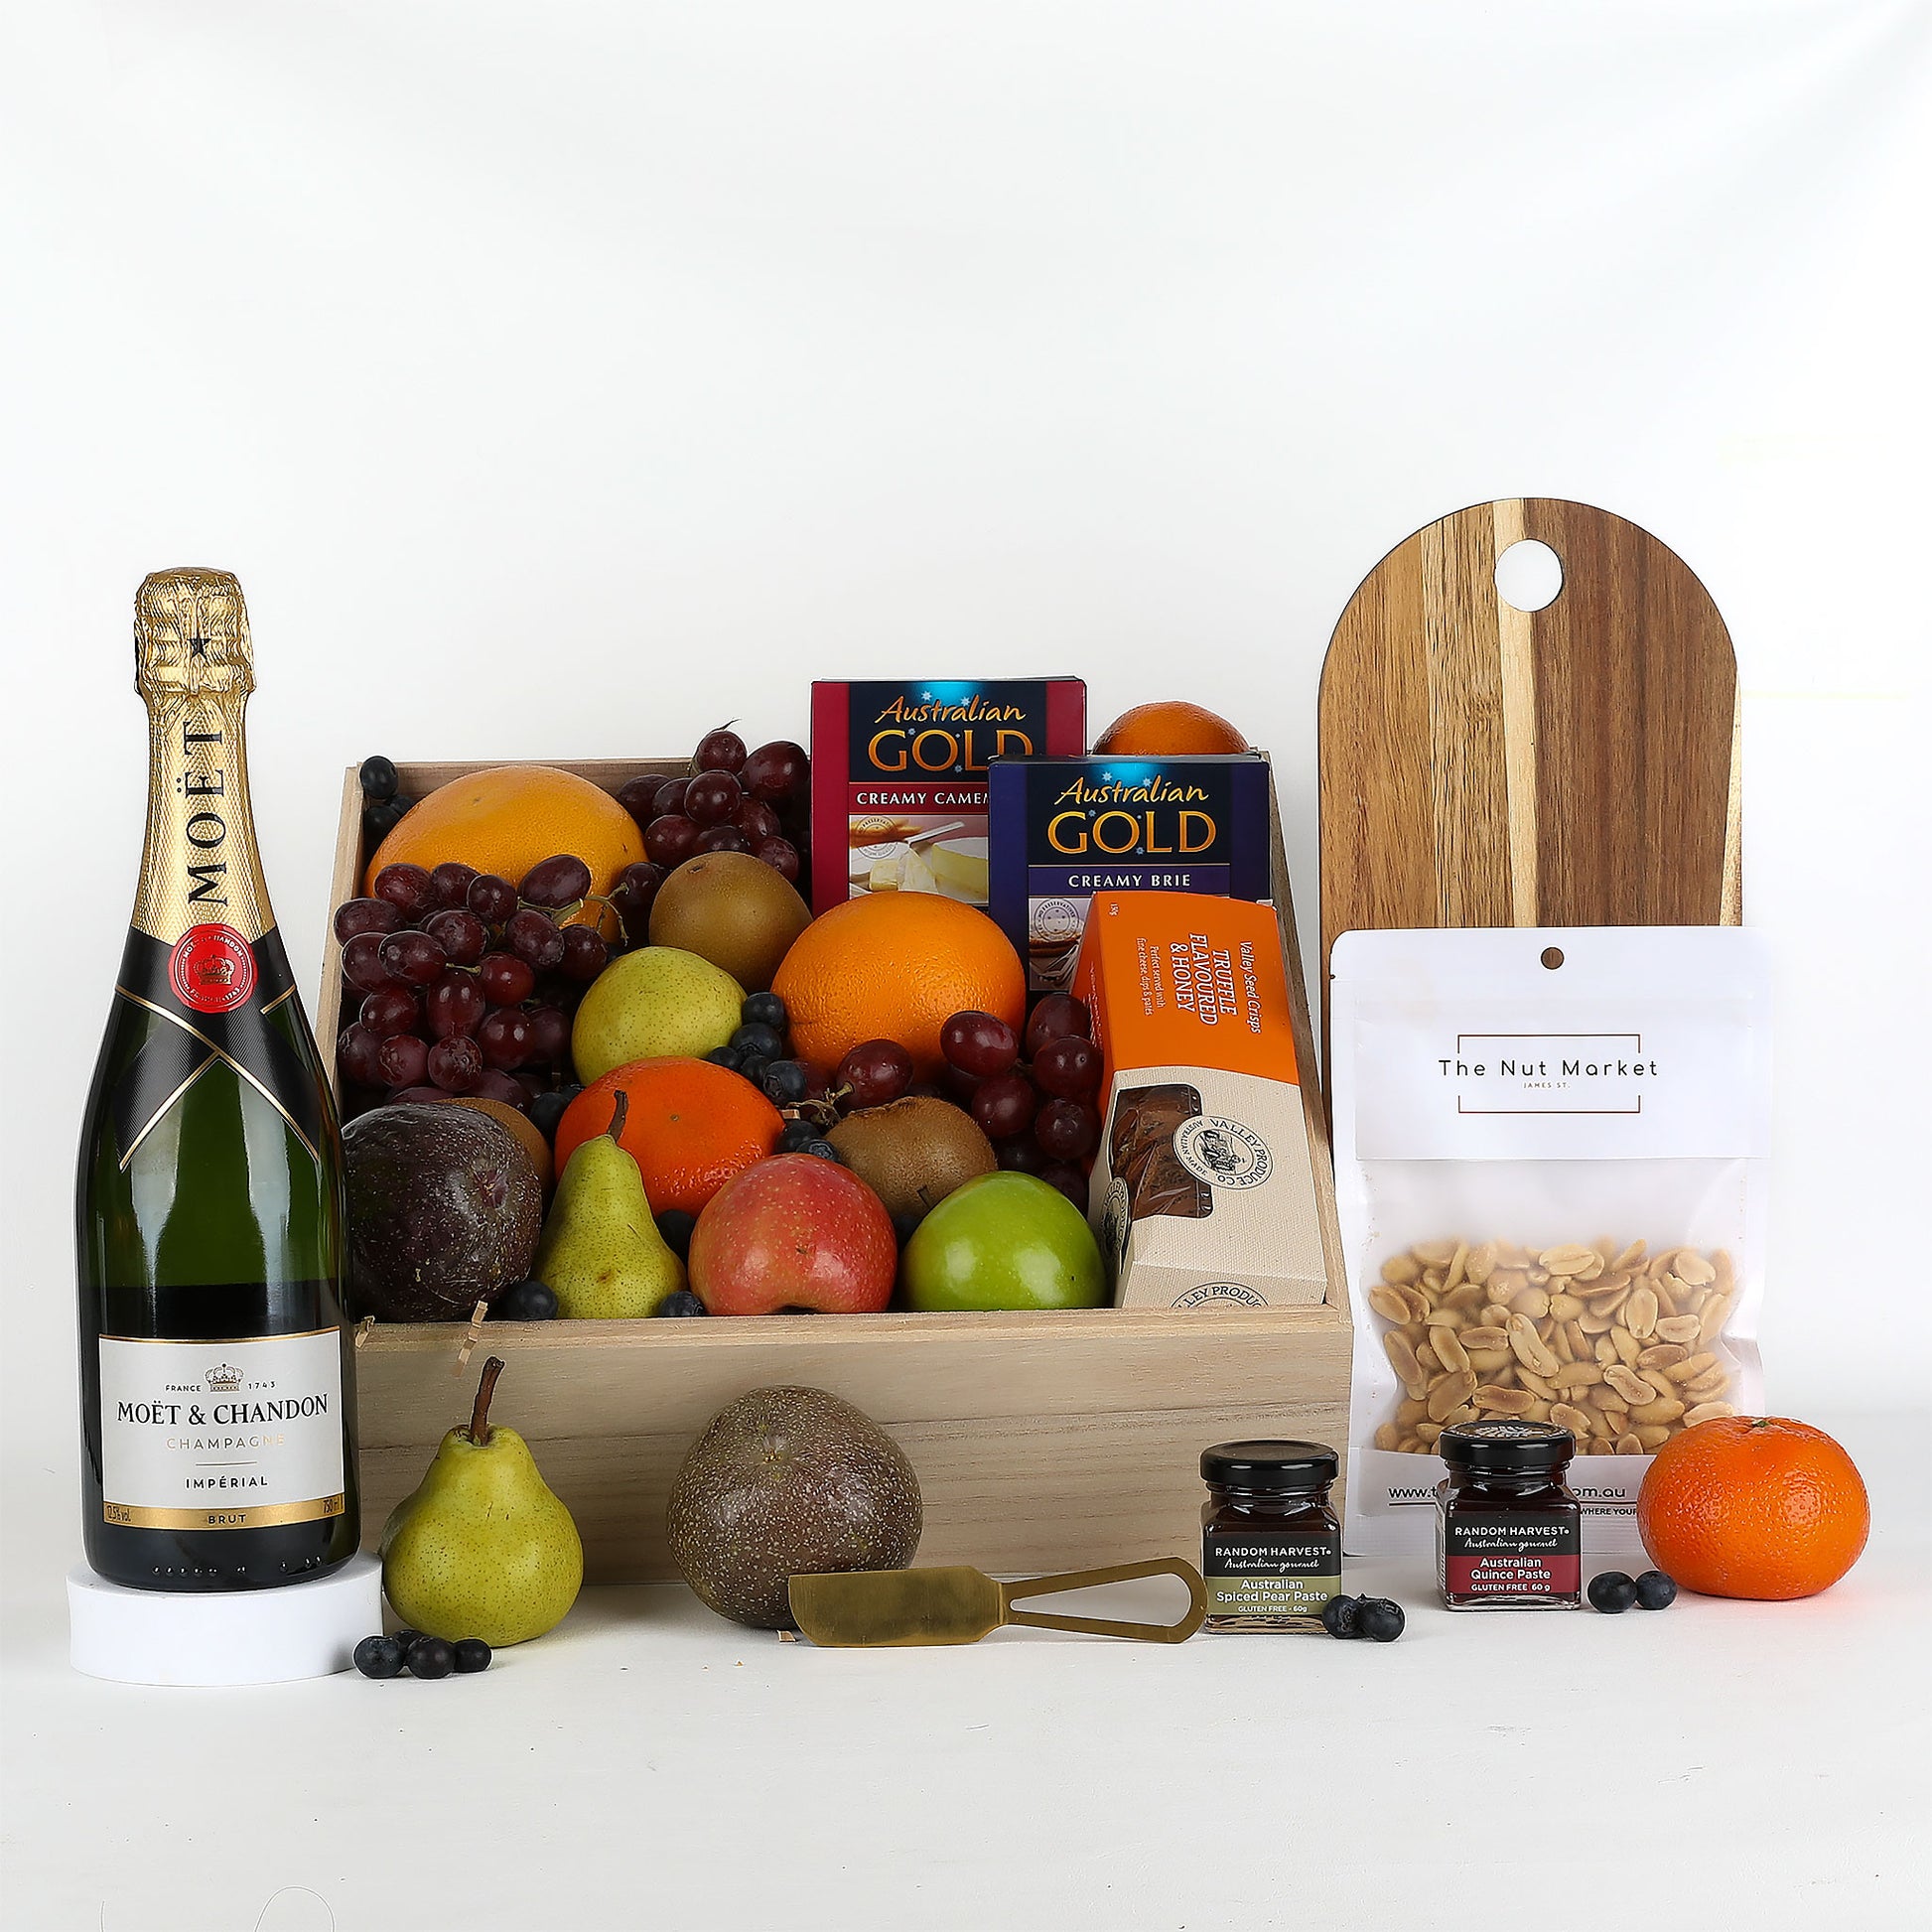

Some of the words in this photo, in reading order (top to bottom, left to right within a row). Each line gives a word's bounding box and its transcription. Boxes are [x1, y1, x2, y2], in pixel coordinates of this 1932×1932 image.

[875, 694, 1027, 724] Australian
[868, 729, 1034, 771] GOLD
[1053, 774, 1209, 805] Australian
[857, 792, 927, 805] CREAMY
[176, 720, 228, 906] MOËT
[1047, 810, 1217, 855] GOLD
[1068, 875, 1143, 888] CREAMY
[1151, 874, 1191, 888] BRIE
[1136, 937, 1148, 952] fine
[1170, 942, 1189, 953] &
[1150, 945, 1162, 969] Perfect
[1239, 941, 1255, 973] Valley
[1140, 975, 1152, 991] dips
[1153, 969, 1165, 992] served
[1171, 956, 1196, 1013] HONEY
[1188, 932, 1219, 1026] FLAVOURED
[1212, 949, 1238, 1016] TRUFFLE
[1244, 974, 1260, 1000] Seed
[1155, 992, 1167, 1009] with
[1247, 1001, 1262, 1034] Crisps
[1439, 1059, 1486, 1076] The
[1501, 1059, 1547, 1076] Nut
[1562, 1059, 1658, 1076] Market
[1209, 1118, 1262, 1148] VALLEY
[1237, 1148, 1269, 1186] PRODUCE
[1215, 1173, 1236, 1186] CO.
[248, 1381, 276, 1390] 1743
[117, 1400, 182, 1426] MOËT
[189, 1404, 207, 1426] &
[213, 1393, 329, 1425] CHANDON
[166, 1434, 285, 1449] CHAMPAGNE
[186, 1474, 268, 1489] IMPÉRIAL
[1389, 1485, 1438, 1498] www.t
[207, 1514, 246, 1525] BRUT
[1455, 1526, 1507, 1536] RANDOM
[1464, 1537, 1518, 1549] Australian
[1215, 1547, 1268, 1557] RANDOM
[1224, 1558, 1280, 1569] Australian
[1480, 1557, 1542, 1568] Australian
[1470, 1569, 1514, 1581] Quince
[1517, 1569, 1551, 1580] Paste
[1240, 1579, 1304, 1589] Australian
[1216, 1590, 1259, 1603] Spiced
[1262, 1591, 1291, 1601] Pear
[1294, 1590, 1328, 1601] Paste
